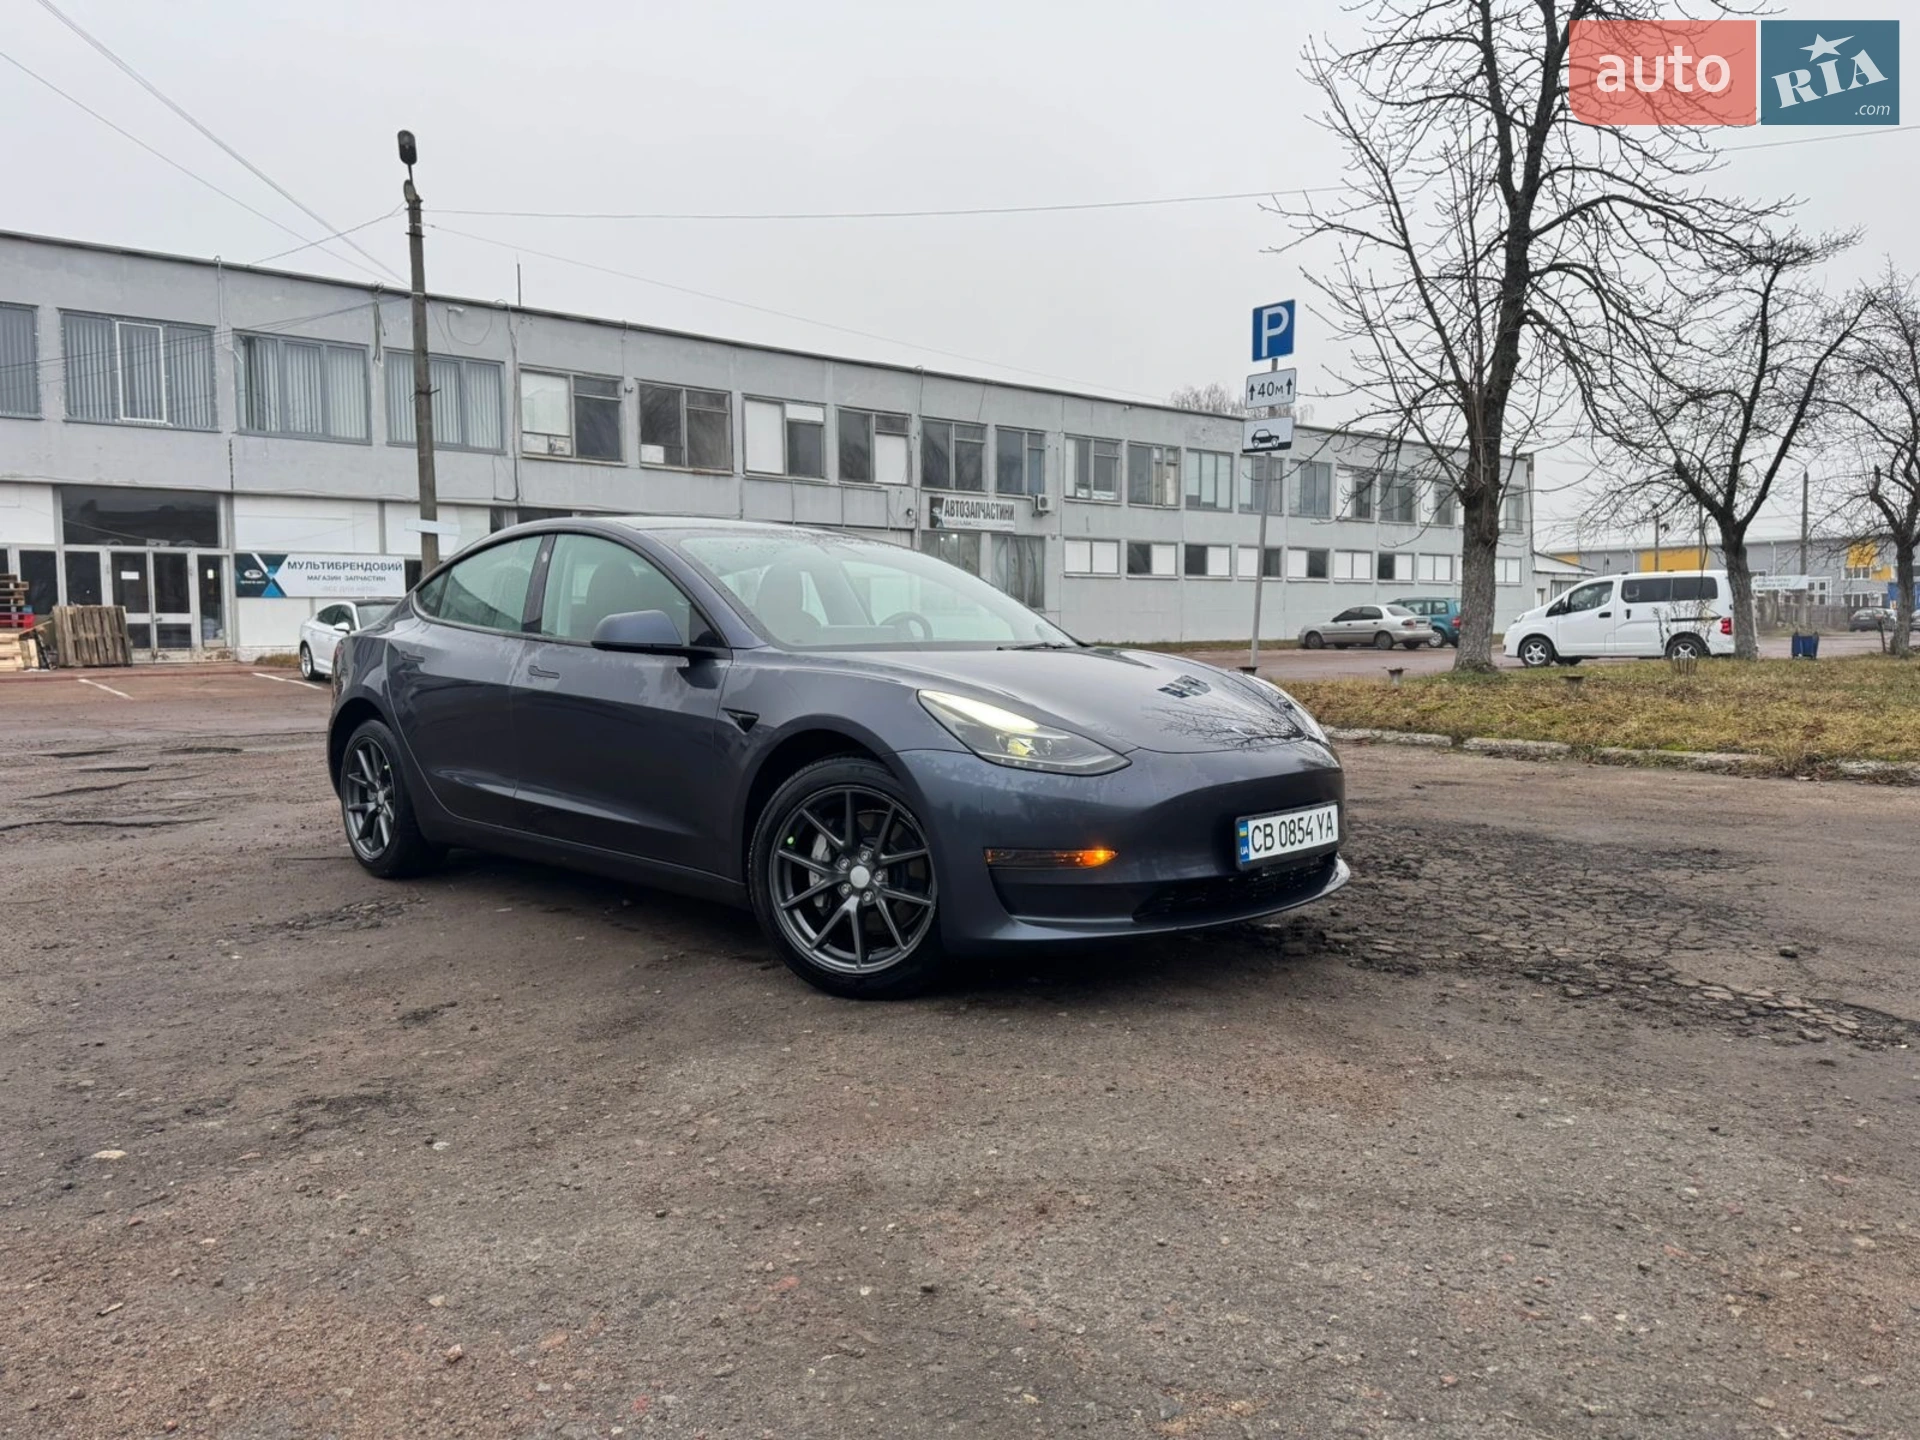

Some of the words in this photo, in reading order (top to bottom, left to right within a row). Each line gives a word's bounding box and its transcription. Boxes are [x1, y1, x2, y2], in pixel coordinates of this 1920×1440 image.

[1261, 305, 1290, 358] P
[944, 499, 1015, 521] АВТОЗАПЧАСТИНИ
[287, 561, 403, 572] МУЛЬТИБРЕНДОВИЙ
[1251, 823, 1275, 853] CB
[1279, 815, 1314, 848] 0854
[1316, 811, 1334, 840] YA
[1240, 846, 1249, 856] UA
